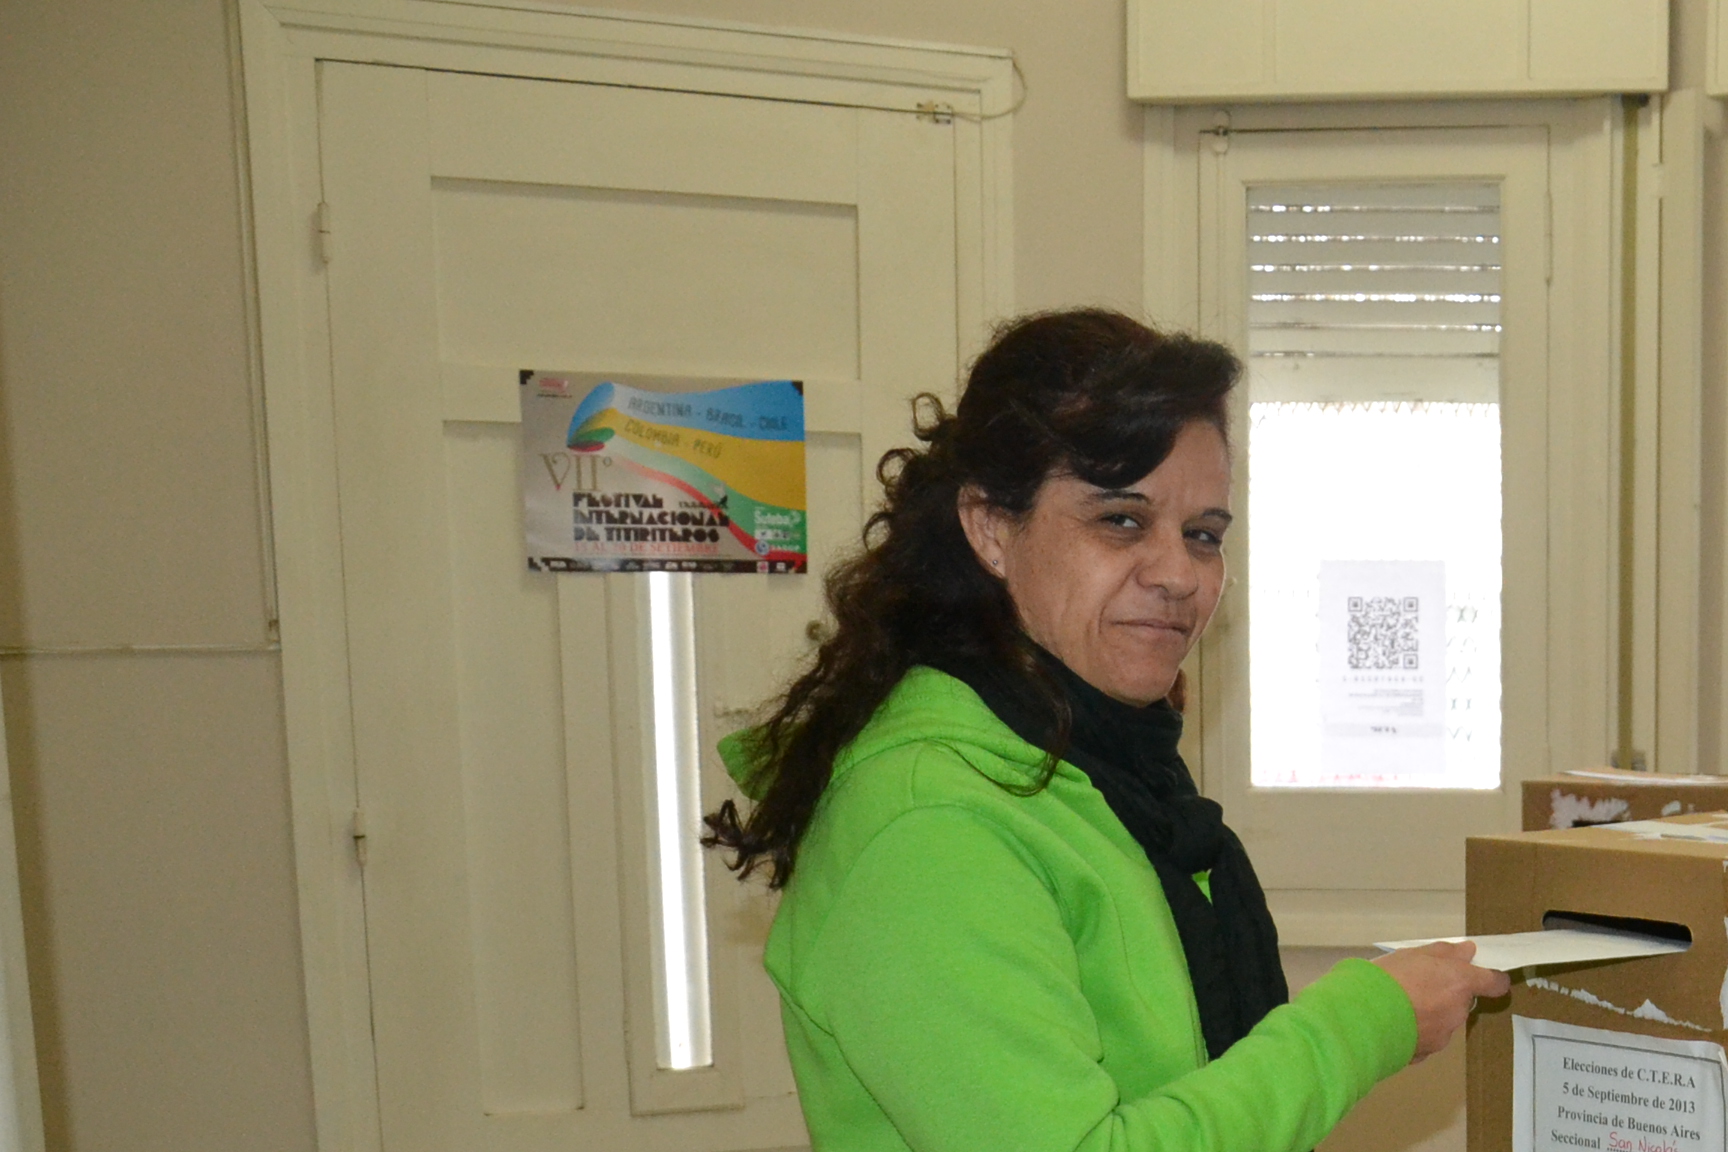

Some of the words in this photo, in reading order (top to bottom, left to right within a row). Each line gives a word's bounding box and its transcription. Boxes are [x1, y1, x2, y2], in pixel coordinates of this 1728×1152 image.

[628, 396, 692, 418] ARGENTINA
[624, 418, 680, 447] COLOMBIA
[573, 492, 664, 508] FESTIVAL
[573, 508, 731, 527] INTERNACIONAL
[1563, 1057, 1618, 1077] Elecciones
[1621, 1065, 1634, 1079] de
[1637, 1067, 1696, 1089] C.T.E.R.A
[1563, 1081, 1569, 1095] 5
[1572, 1083, 1584, 1097] de
[1588, 1085, 1649, 1107] Septiembre
[1652, 1095, 1666, 1110] de
[1669, 1098, 1695, 1114] 2013
[1558, 1105, 1608, 1126] Provincia
[1611, 1114, 1624, 1129] de
[1628, 1116, 1667, 1135] Buenos
[1670, 1123, 1700, 1141] Aires
[1551, 1129, 1601, 1150] Seccional
[1609, 1130, 1633, 1152] San
